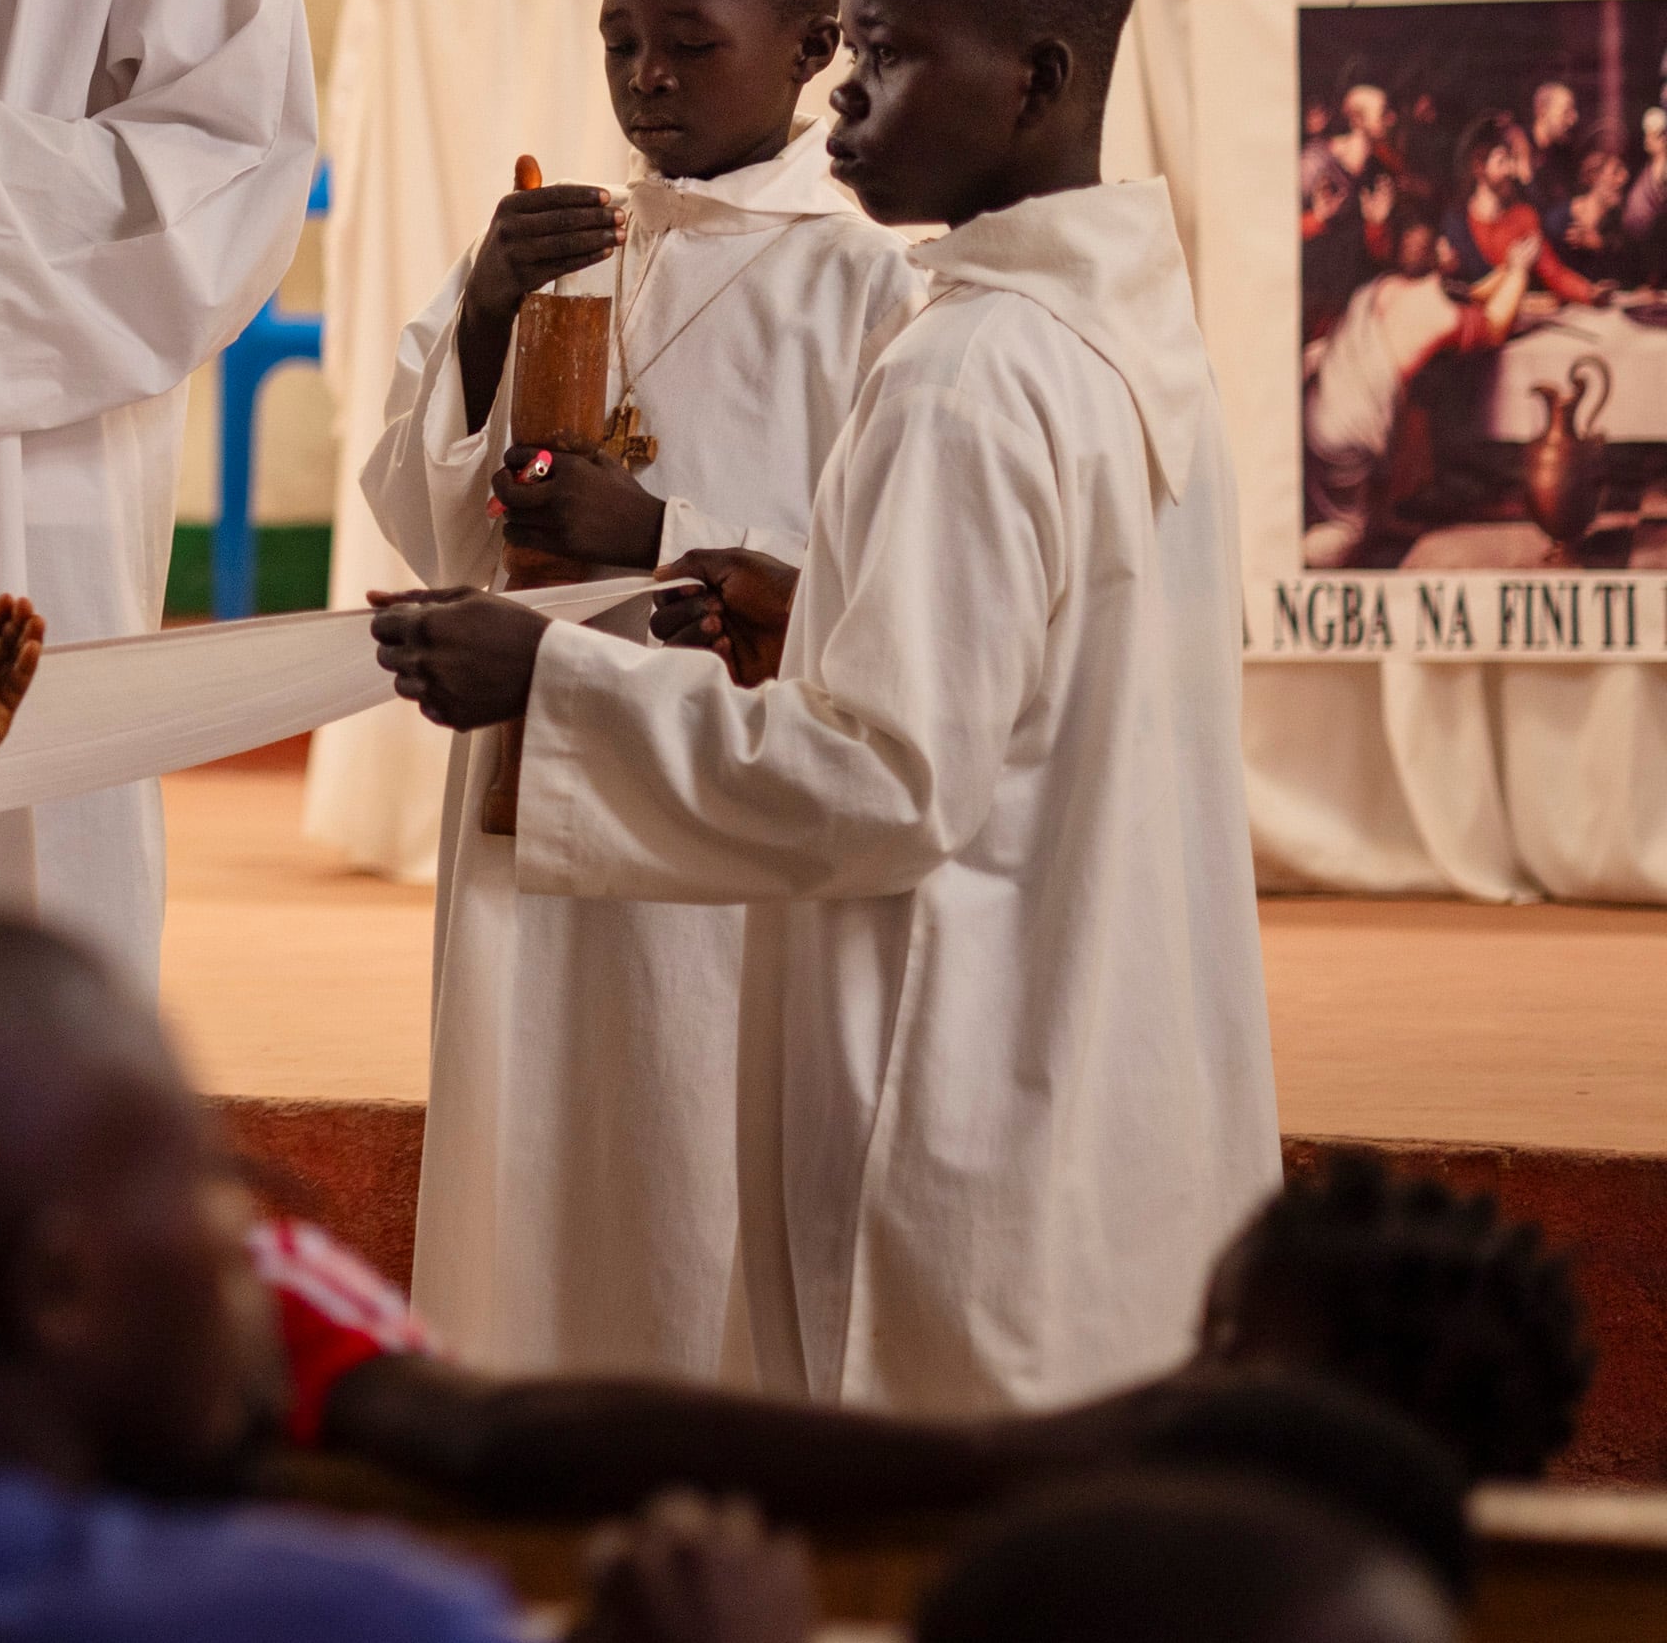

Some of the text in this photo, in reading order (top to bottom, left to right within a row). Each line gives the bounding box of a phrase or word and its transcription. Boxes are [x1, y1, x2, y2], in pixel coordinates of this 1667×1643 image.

[1274, 582, 1393, 650] NGBA
[1416, 582, 1475, 649] NA
[1499, 582, 1581, 648] FINI
[1594, 582, 1637, 648] TI
